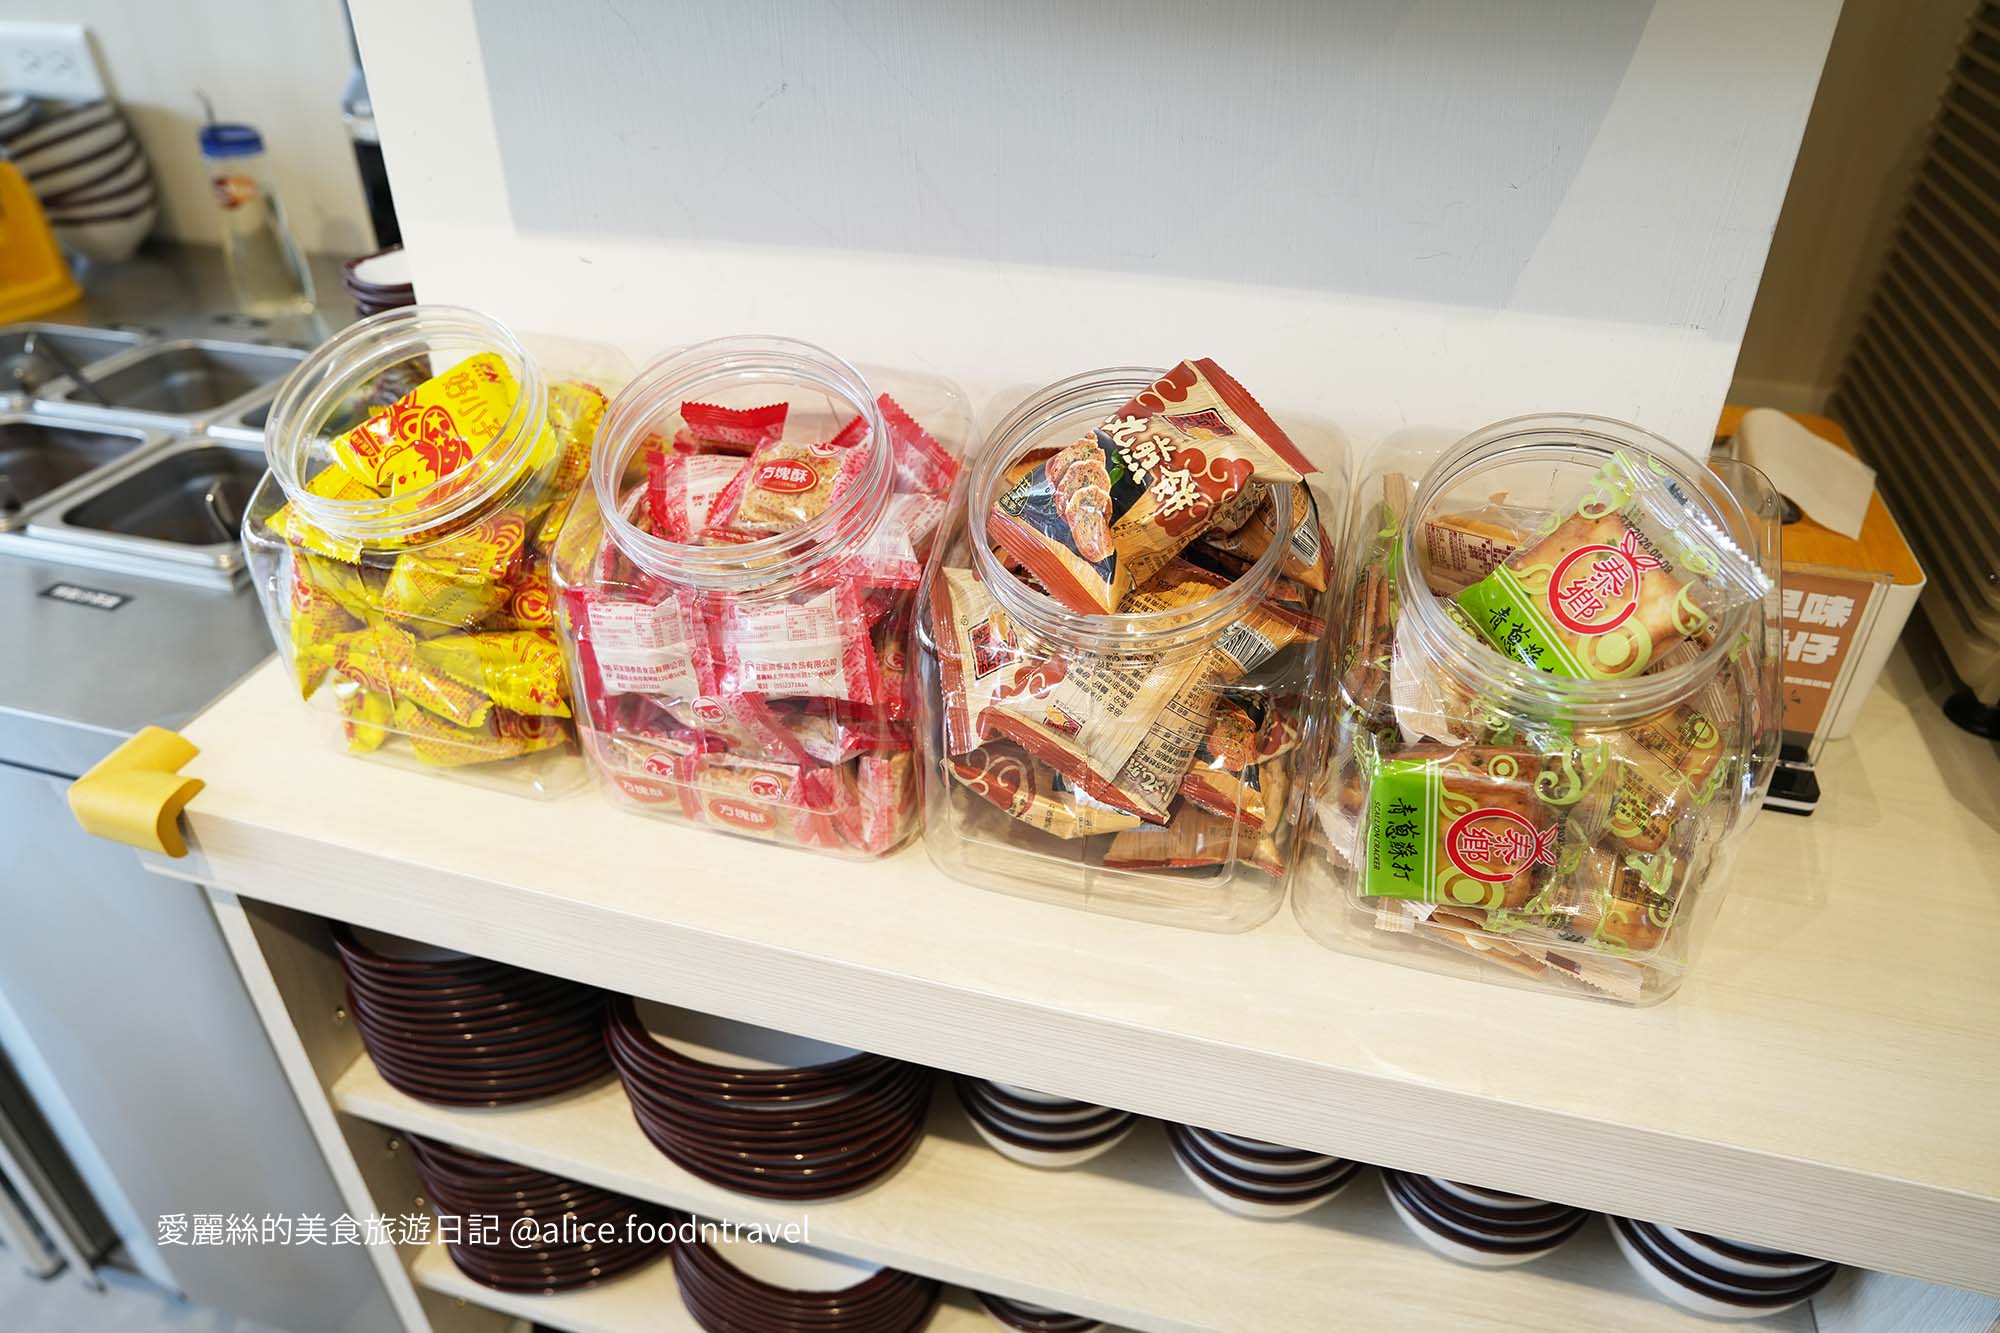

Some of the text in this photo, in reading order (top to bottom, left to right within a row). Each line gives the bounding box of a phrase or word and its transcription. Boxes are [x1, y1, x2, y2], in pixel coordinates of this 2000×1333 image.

[760, 466, 808, 483] 方塊酥
[1373, 801, 1382, 871] SCALLION CRACKER
